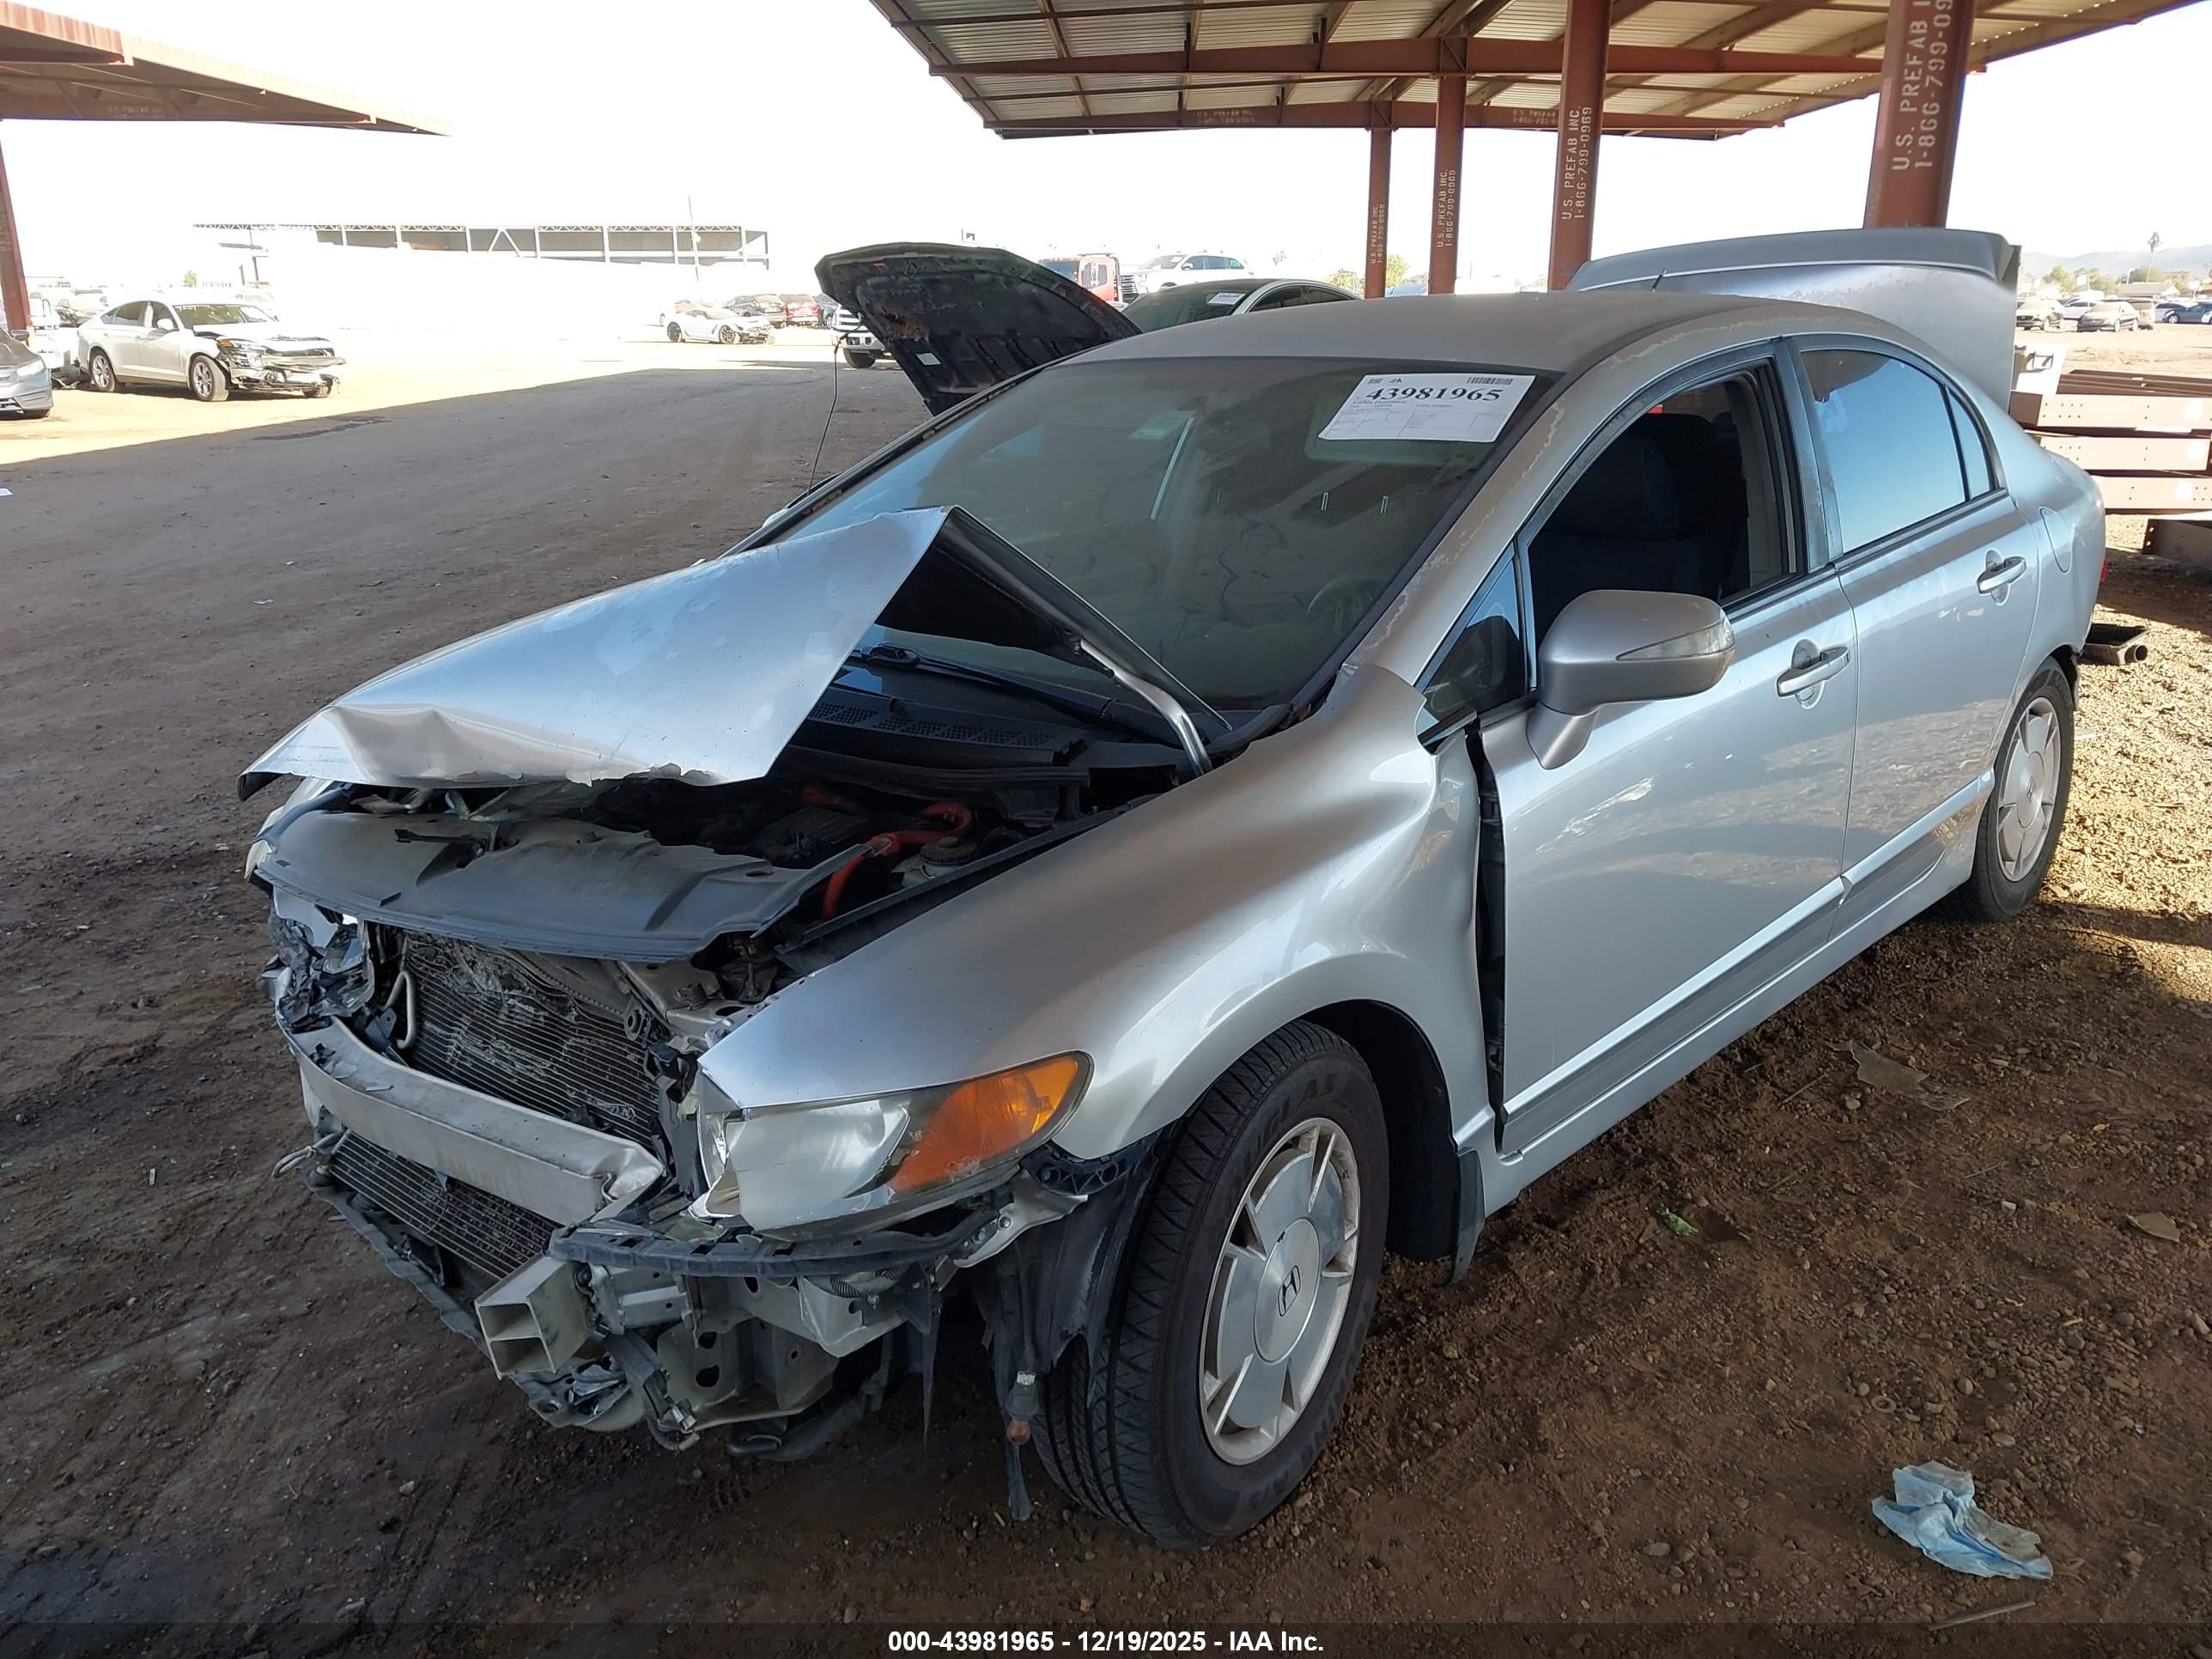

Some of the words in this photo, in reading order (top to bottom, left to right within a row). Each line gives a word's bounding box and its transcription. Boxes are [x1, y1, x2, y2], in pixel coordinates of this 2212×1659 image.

[1899, 20, 1929, 112] PREFAB
[1568, 106, 1581, 131] INC.
[1564, 137, 1578, 188] PREFAB
[1892, 126, 1915, 171] U.S.
[1561, 195, 1574, 220] U.S.
[1365, 387, 1504, 402] 43981965
